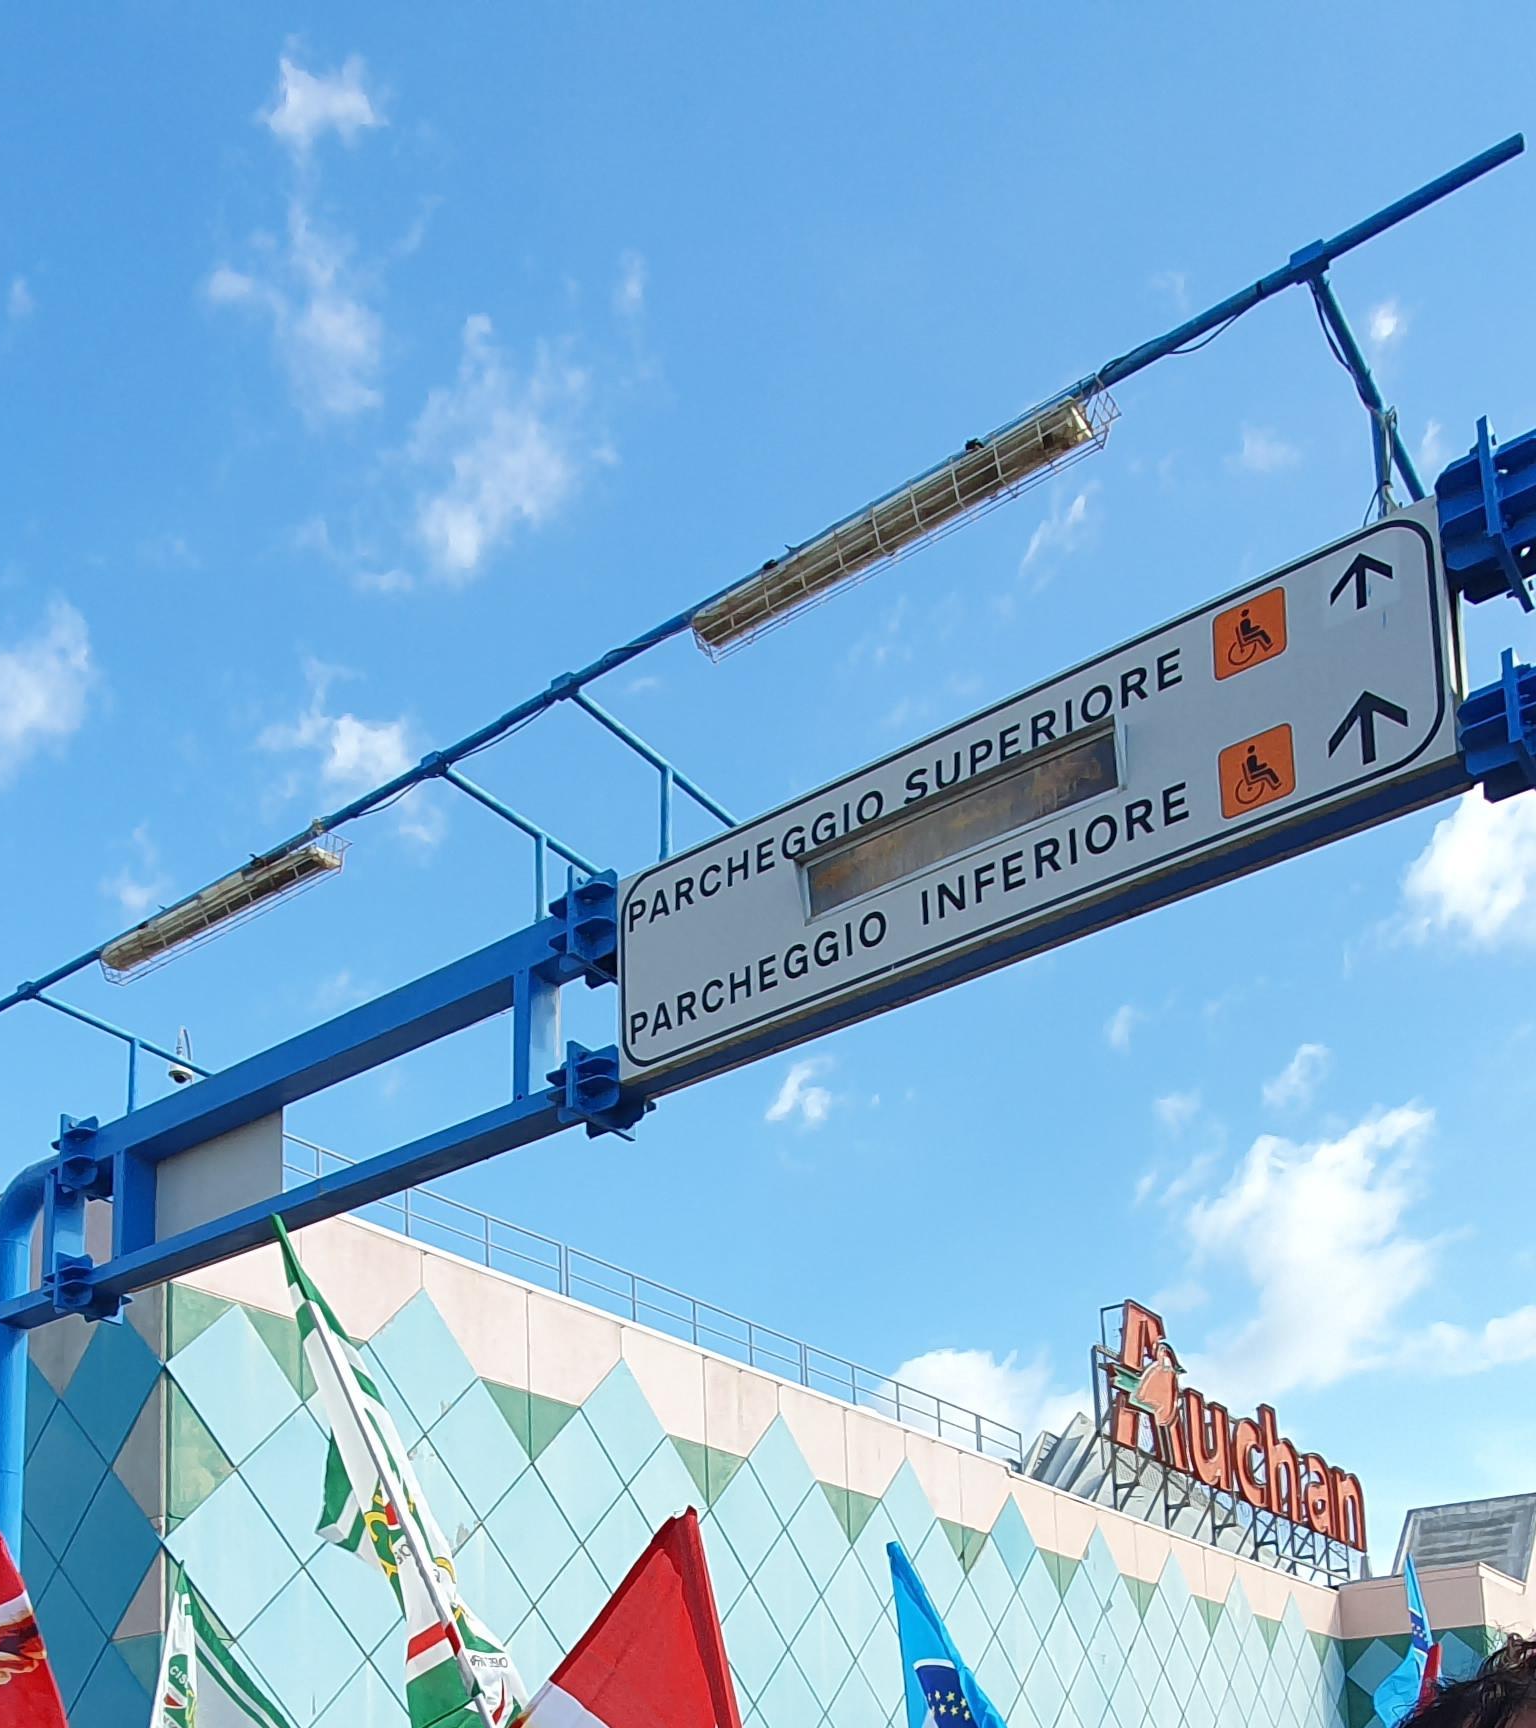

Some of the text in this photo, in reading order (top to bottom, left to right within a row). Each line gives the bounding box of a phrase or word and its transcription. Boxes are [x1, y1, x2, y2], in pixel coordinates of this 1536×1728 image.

[628, 648, 1184, 933] PARCHEGGIO SUPERIORE
[629, 780, 1190, 1046] PARCHEGGIO INFERIORE
[1110, 1298, 1368, 1553] Auchan
